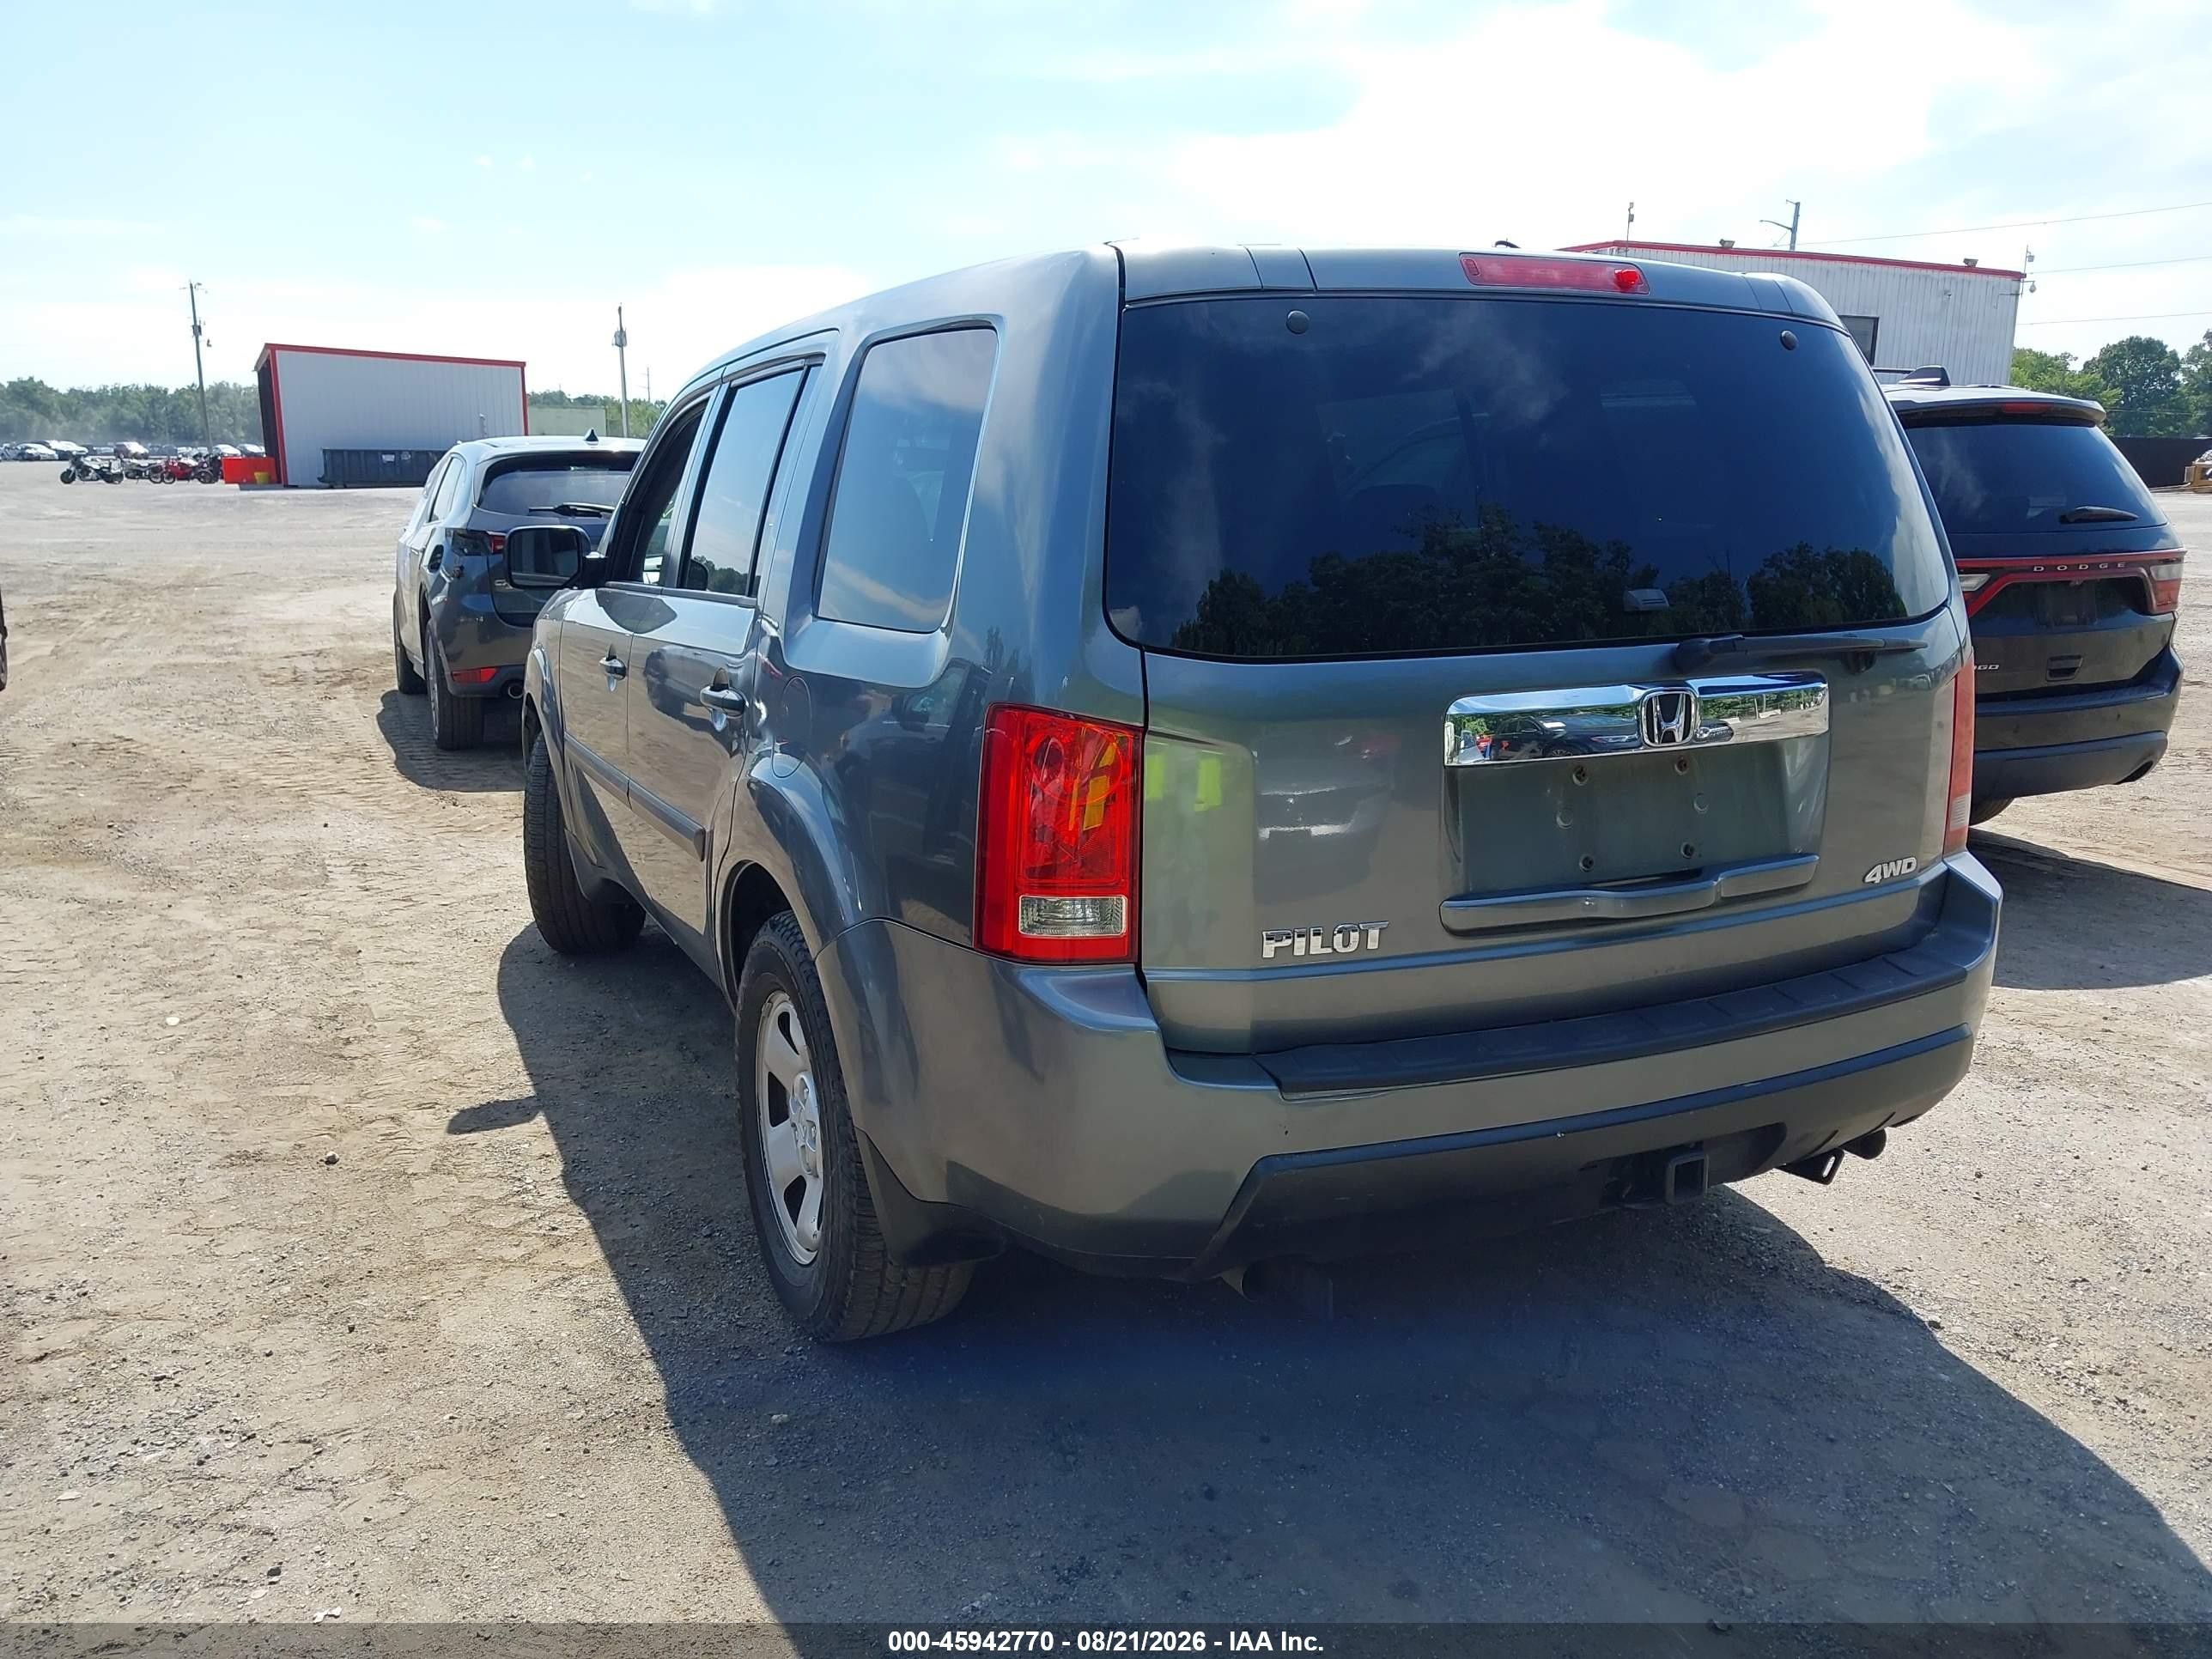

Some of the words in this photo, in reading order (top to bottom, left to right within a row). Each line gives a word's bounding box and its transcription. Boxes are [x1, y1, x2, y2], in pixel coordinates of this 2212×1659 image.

[2033, 562, 2127, 572] DODGE
[1863, 856, 1917, 884] 4WD
[1261, 921, 1390, 959] PILOT
